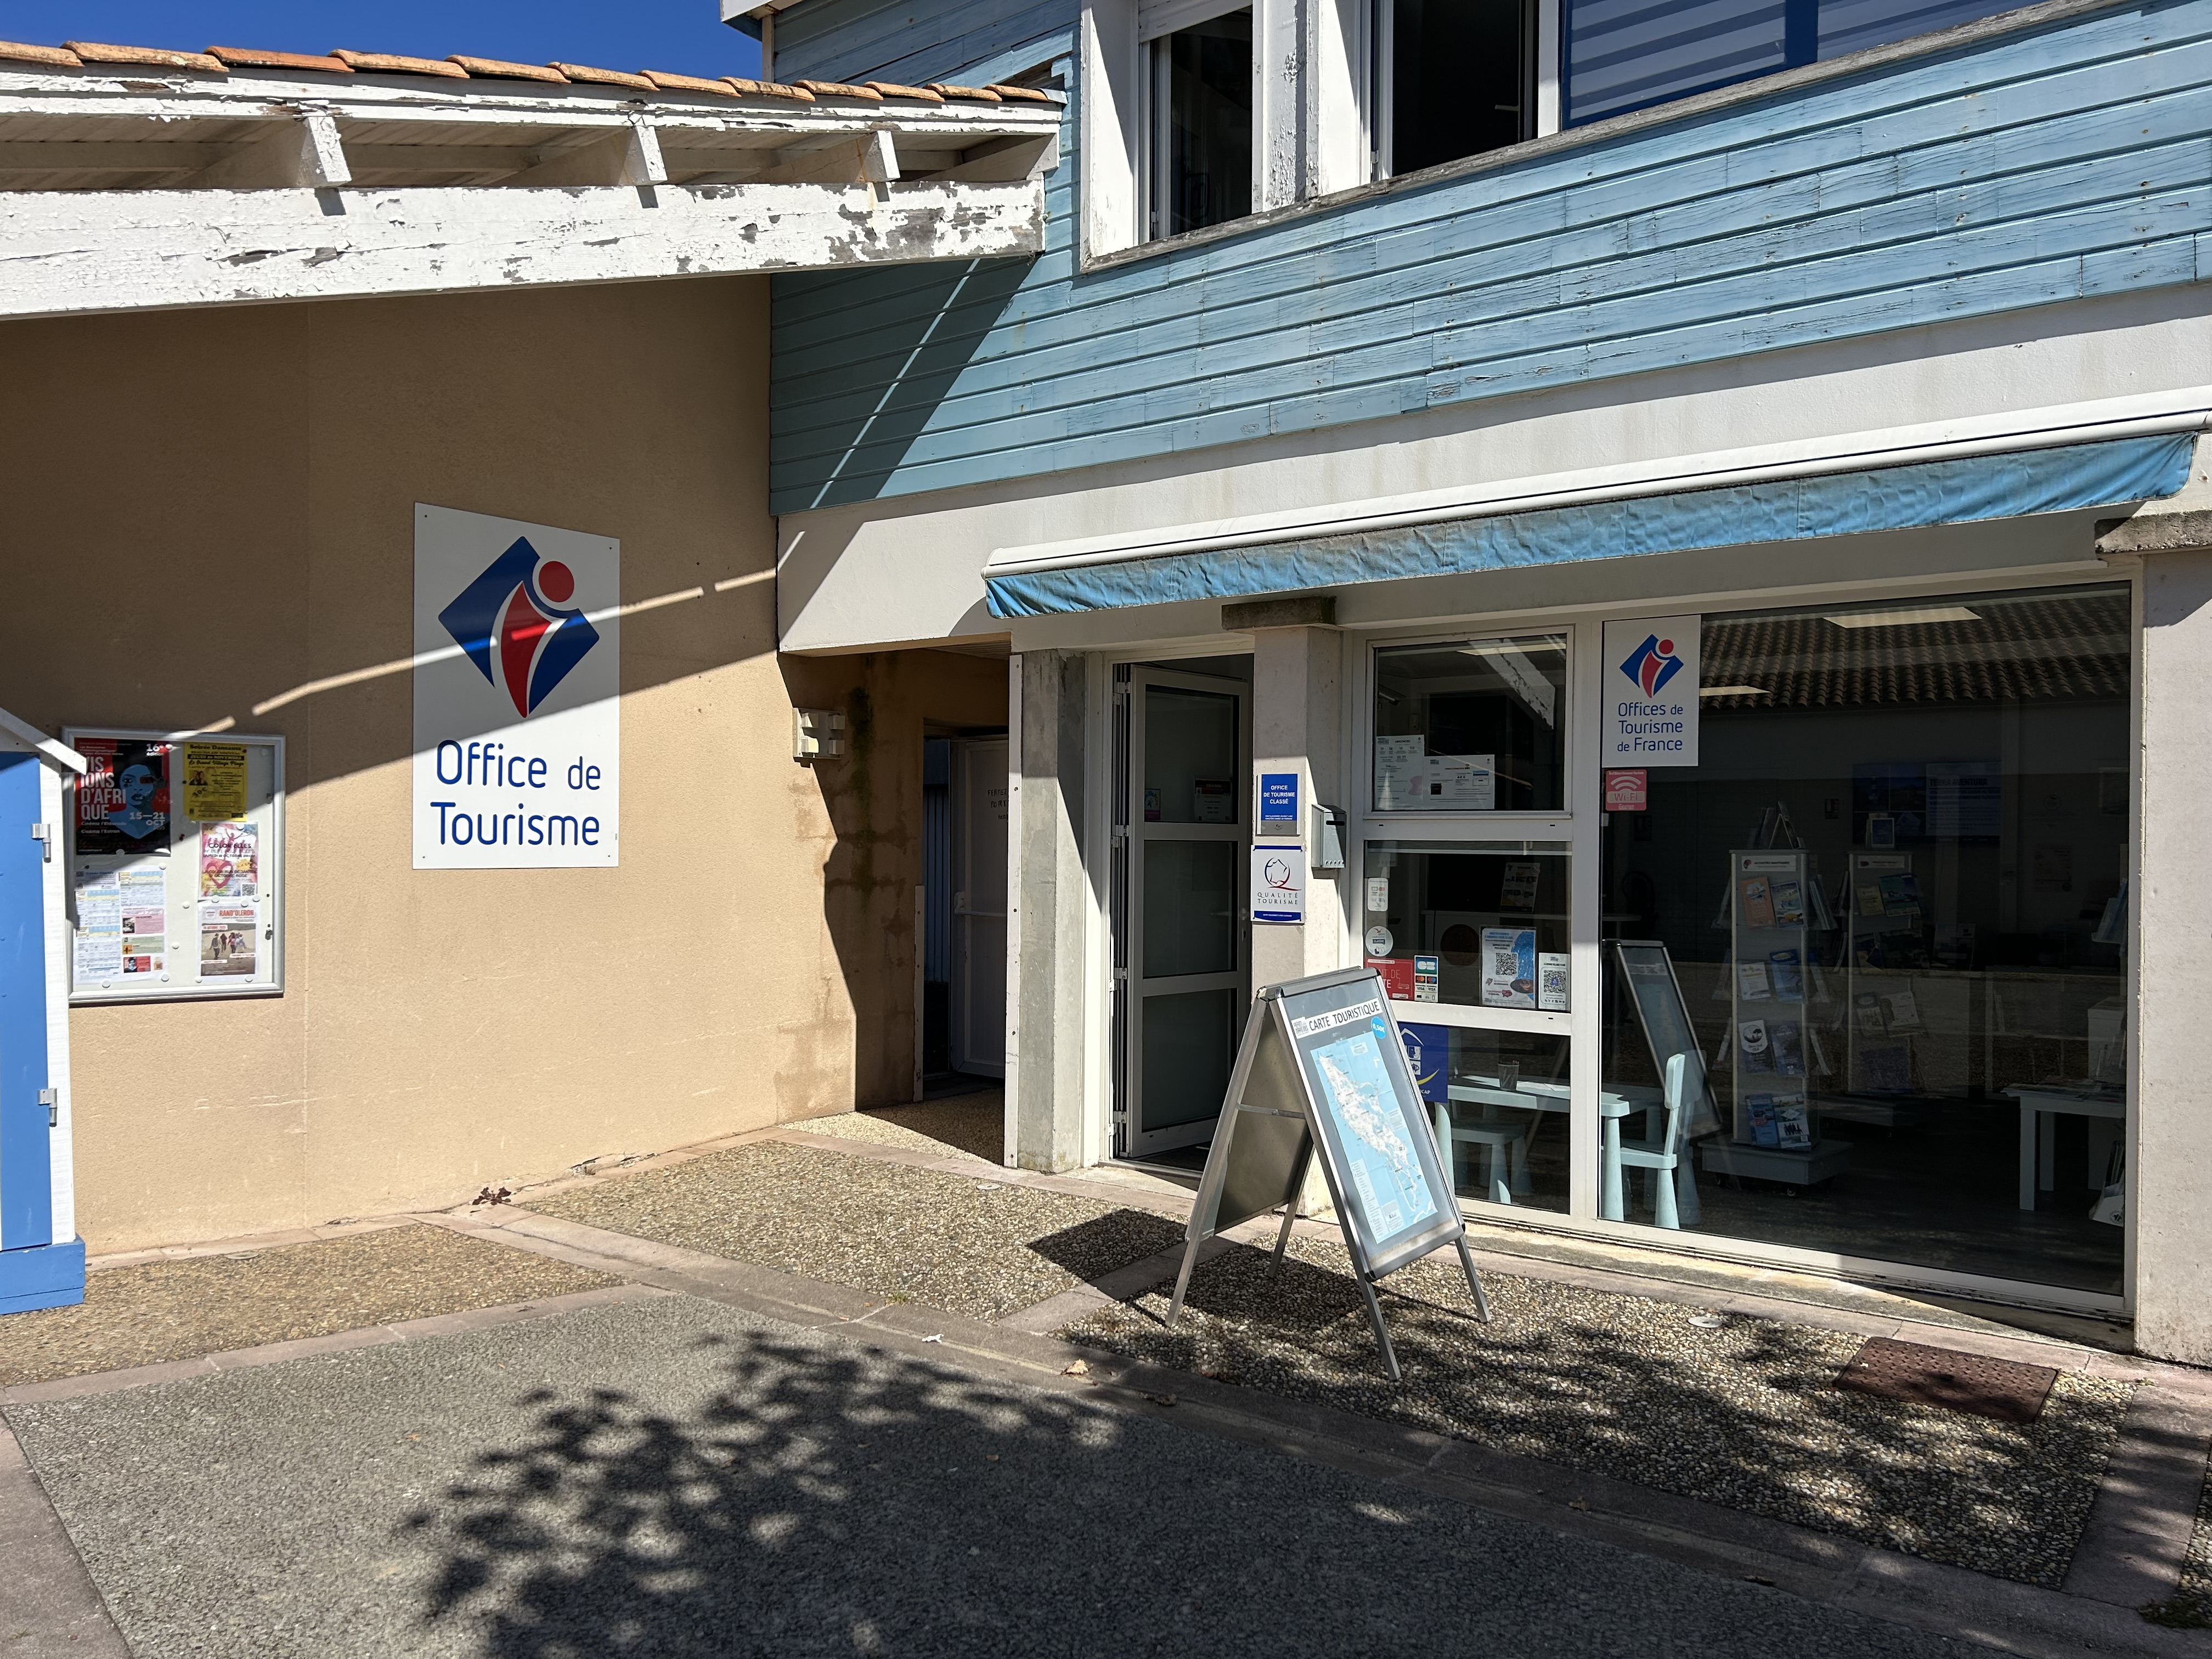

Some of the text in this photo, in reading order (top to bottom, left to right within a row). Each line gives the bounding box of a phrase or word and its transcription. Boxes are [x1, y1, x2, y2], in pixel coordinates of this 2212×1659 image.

[1618, 702, 1683, 716] Offices de
[1618, 719, 1683, 735] Tourisme
[1617, 737, 1683, 752] de France
[437, 740, 601, 790] Office de
[81, 772, 115, 788] IONS
[81, 788, 126, 804] D'AFRI
[1615, 793, 1638, 802] Wi-Fi
[81, 804, 110, 821] QUE
[430, 802, 600, 845] Tourisme
[1391, 969, 1401, 979] DE
[1309, 1001, 1380, 1031] CARTE TOURISTIQUE
